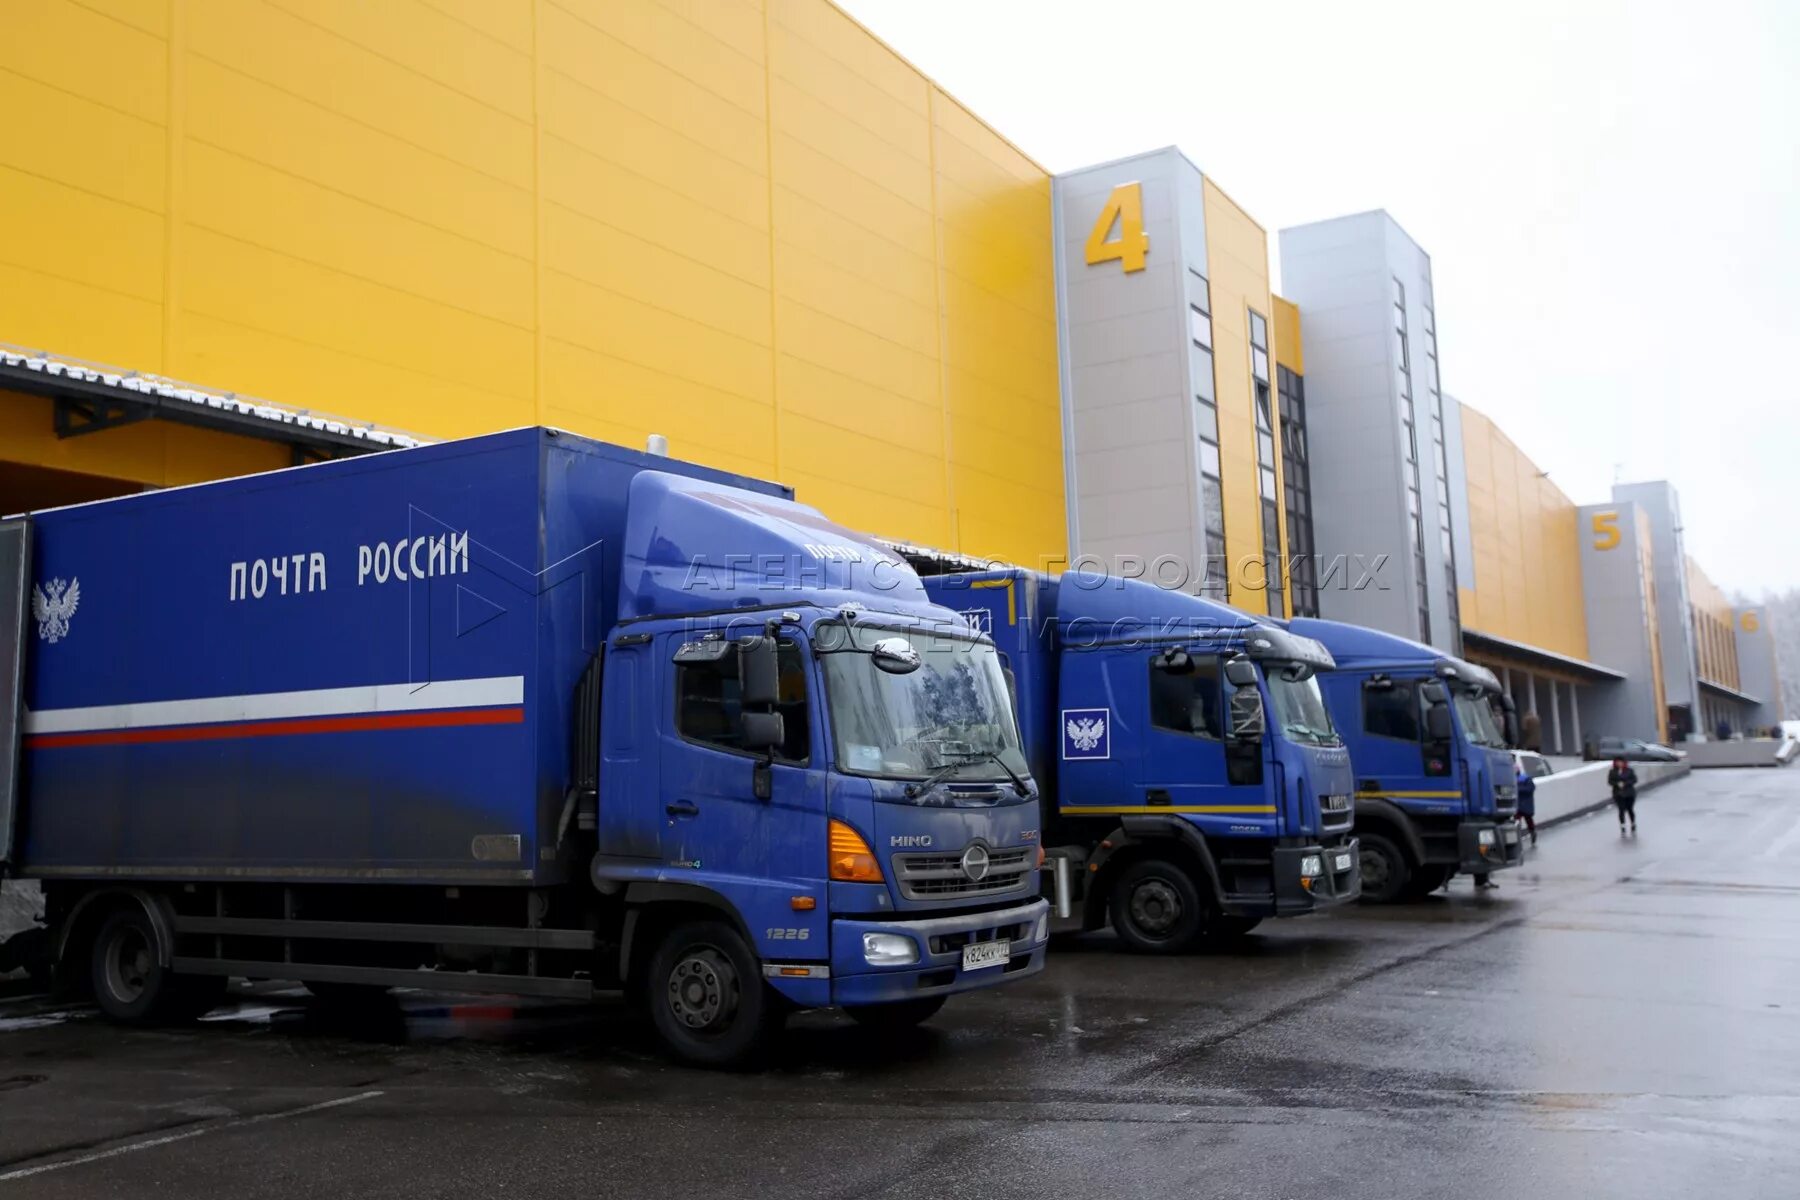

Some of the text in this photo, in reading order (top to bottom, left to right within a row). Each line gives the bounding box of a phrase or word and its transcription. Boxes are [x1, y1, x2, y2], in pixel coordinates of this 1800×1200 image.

[1084, 180, 1149, 273] 4
[1592, 510, 1621, 550] 5
[230, 529, 469, 601] ПОЧТА РОССИИ
[1741, 609, 1759, 634] 6
[890, 835, 932, 847] HINO
[766, 928, 810, 940] 1226
